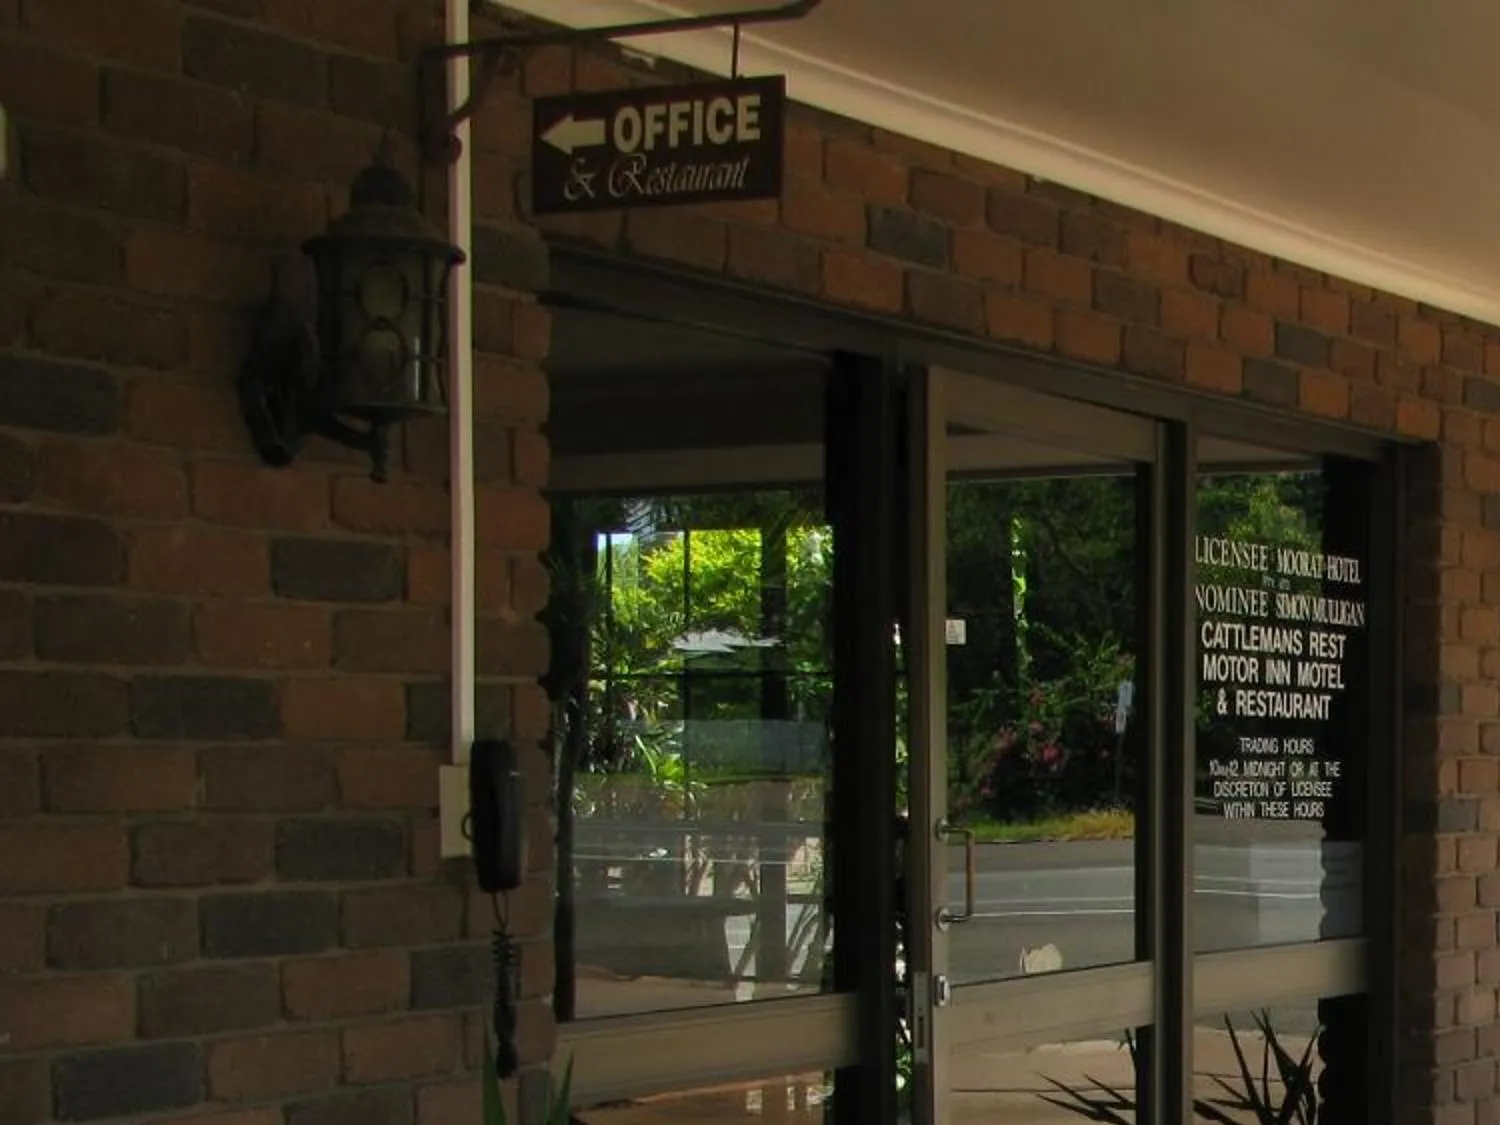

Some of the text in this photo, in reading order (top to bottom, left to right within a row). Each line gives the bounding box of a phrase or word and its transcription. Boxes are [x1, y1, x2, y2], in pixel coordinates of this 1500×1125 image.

[613, 95, 760, 152] OFFICE
[563, 153, 750, 200] & Restaurant
[1195, 535, 1268, 572] LICENSEE
[1195, 584, 1269, 618] NOMINEE
[1201, 621, 1347, 659] CATTLEMANS REST
[1203, 653, 1344, 689] MOTOR INN MOTEL
[1217, 687, 1332, 720] & RESTAURANT
[1240, 737, 1314, 755] TRADING HOURS
[1243, 760, 1285, 777] MIDNIGHT
[1289, 761, 1304, 777] OR
[1324, 761, 1341, 777] THE
[1213, 781, 1333, 798] DISCRETION OF LICENSEE
[1223, 801, 1325, 819] WITHIN THESE HOURS
